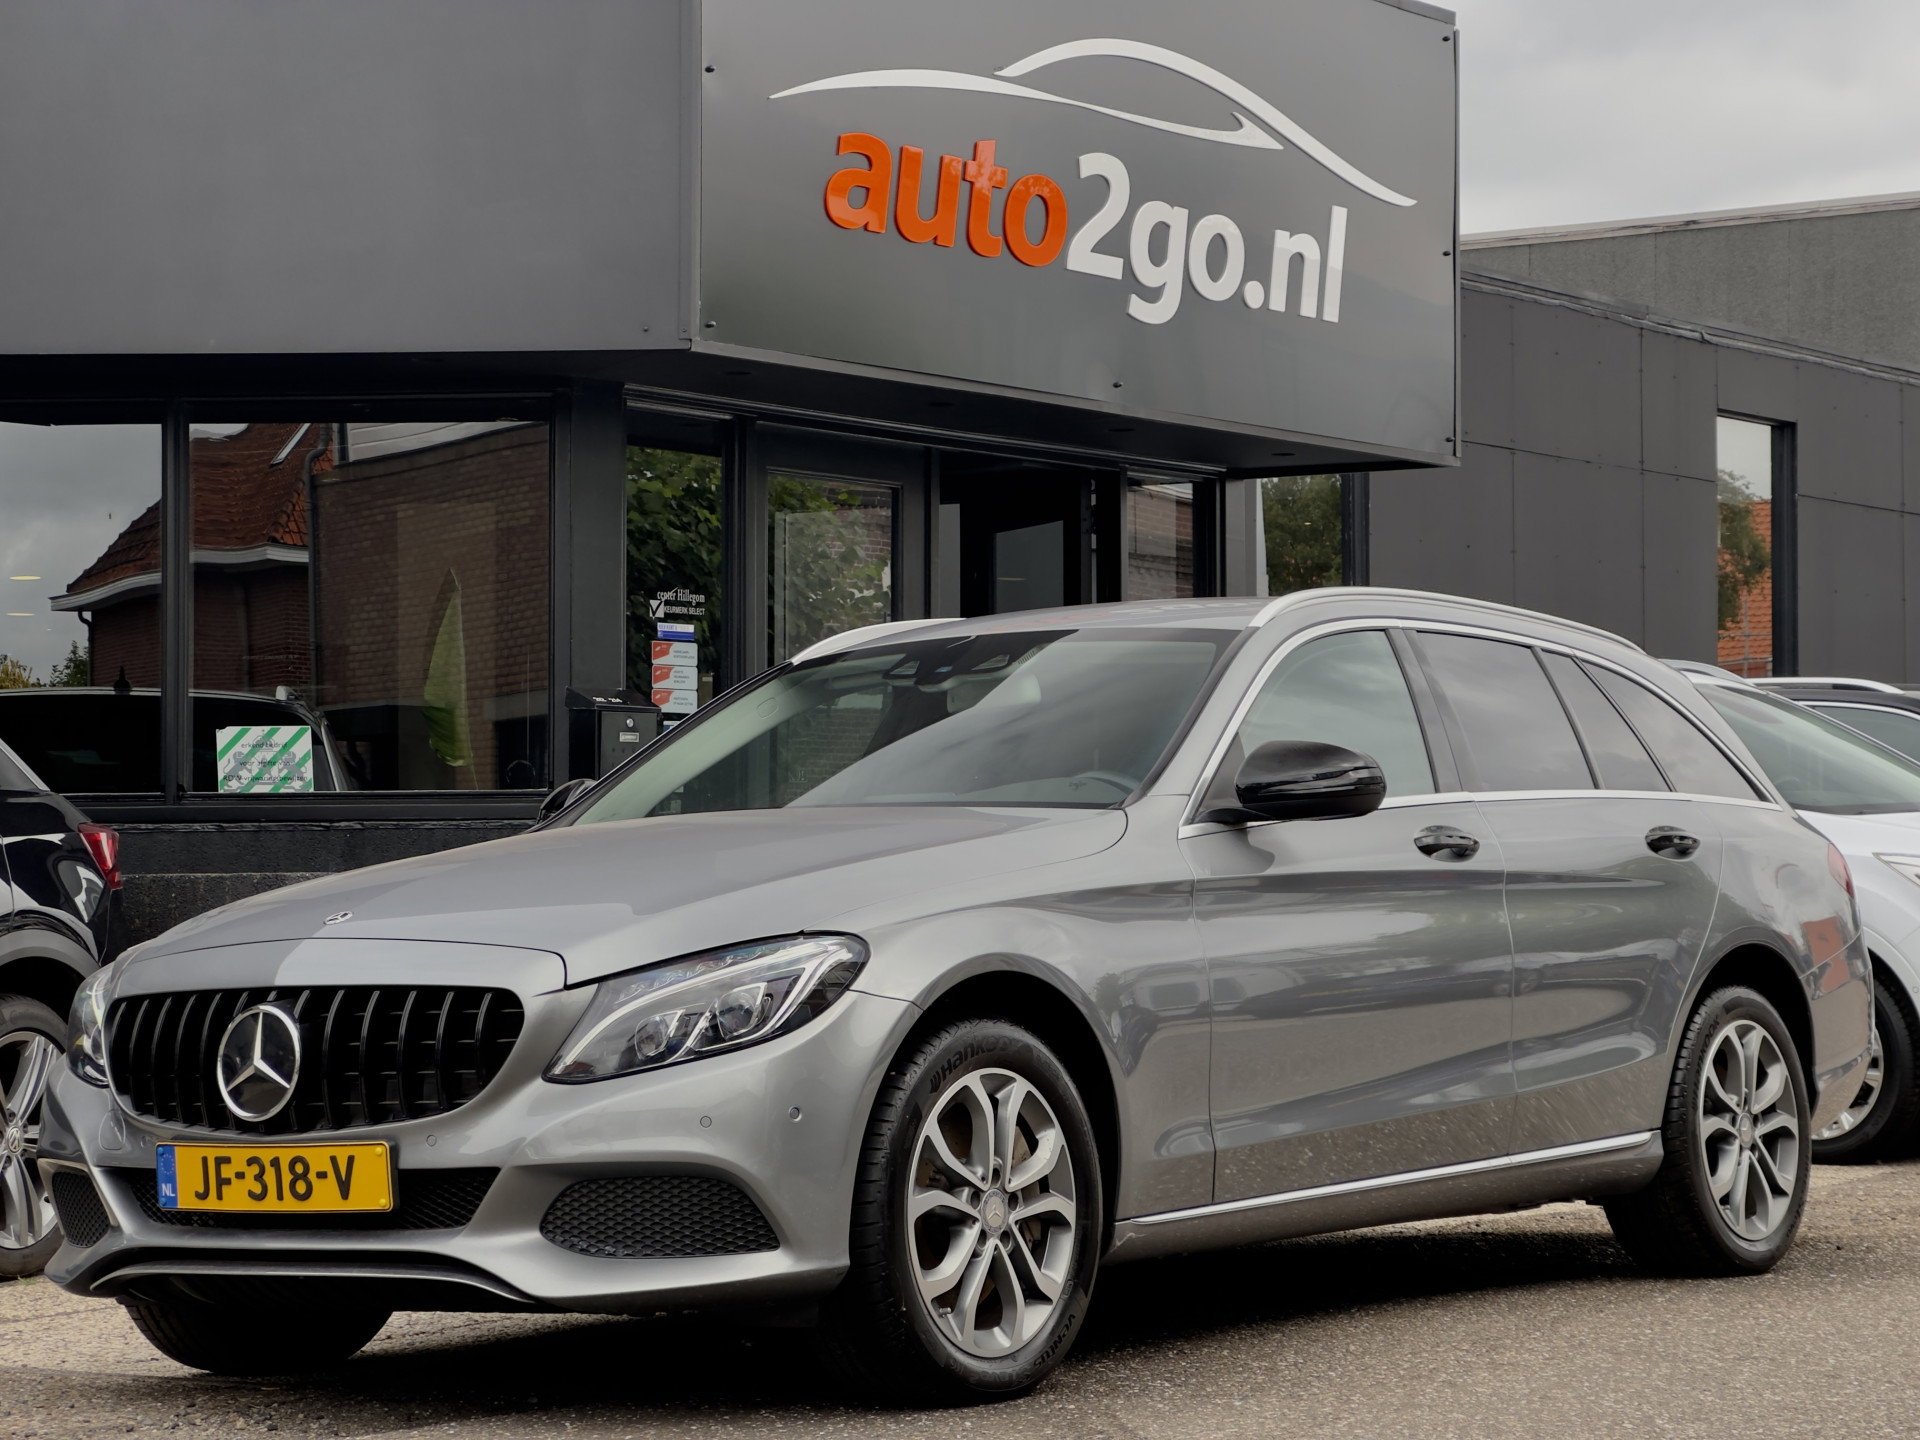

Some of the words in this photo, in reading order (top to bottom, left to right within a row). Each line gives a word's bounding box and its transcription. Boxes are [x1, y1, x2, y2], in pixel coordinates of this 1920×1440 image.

[824, 132, 1348, 324] auto2go.nl
[677, 589, 705, 606] Hillegom
[664, 605, 688, 614] KEURMERK
[689, 607, 705, 616] SELECT
[194, 1154, 356, 1202] JF-318-V
[161, 1183, 176, 1197] NL
